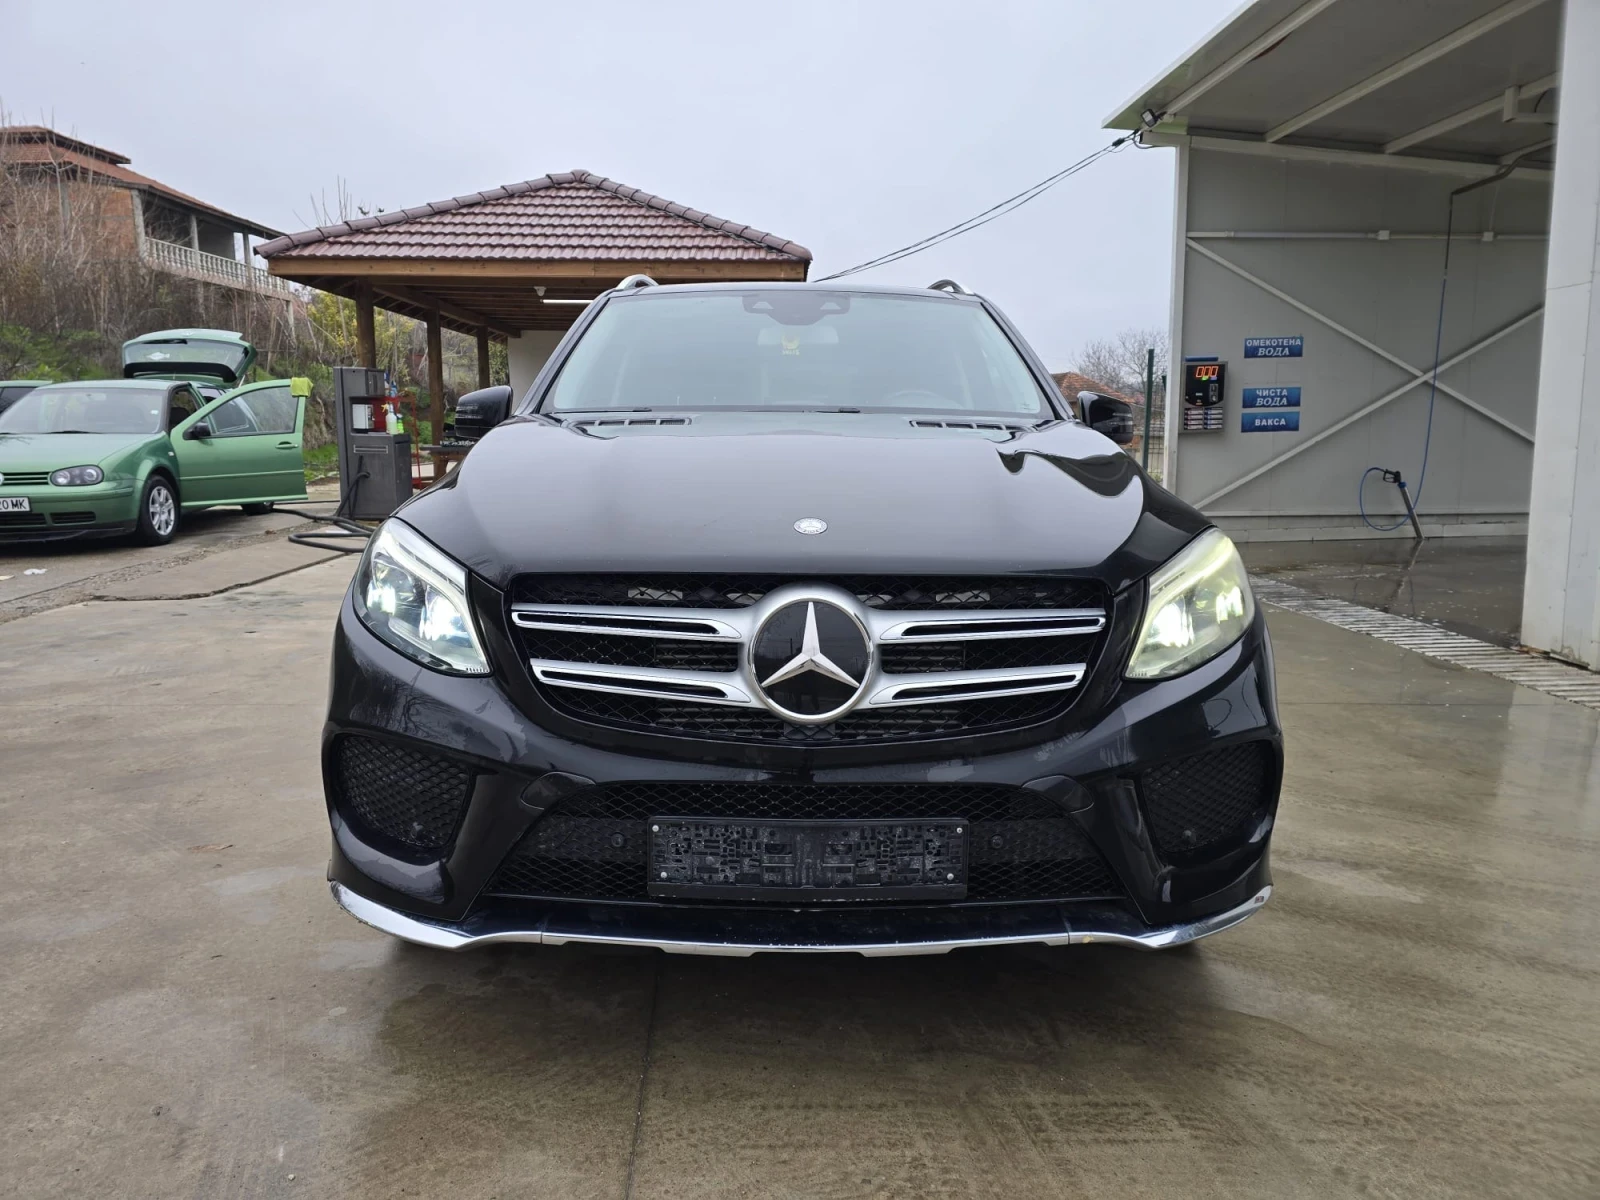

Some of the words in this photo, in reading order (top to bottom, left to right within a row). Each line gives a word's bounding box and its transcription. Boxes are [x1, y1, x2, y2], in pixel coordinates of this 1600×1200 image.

[1246, 339, 1301, 347] ОМЕКОТЕНА
[1257, 347, 1290, 356] ВОДА
[1195, 366, 1219, 378] 000
[1256, 389, 1288, 397] ЧИСТА
[1255, 397, 1288, 406] ВОДА
[1254, 418, 1286, 426] ВАКСА
[11, 499, 26, 510] MK
